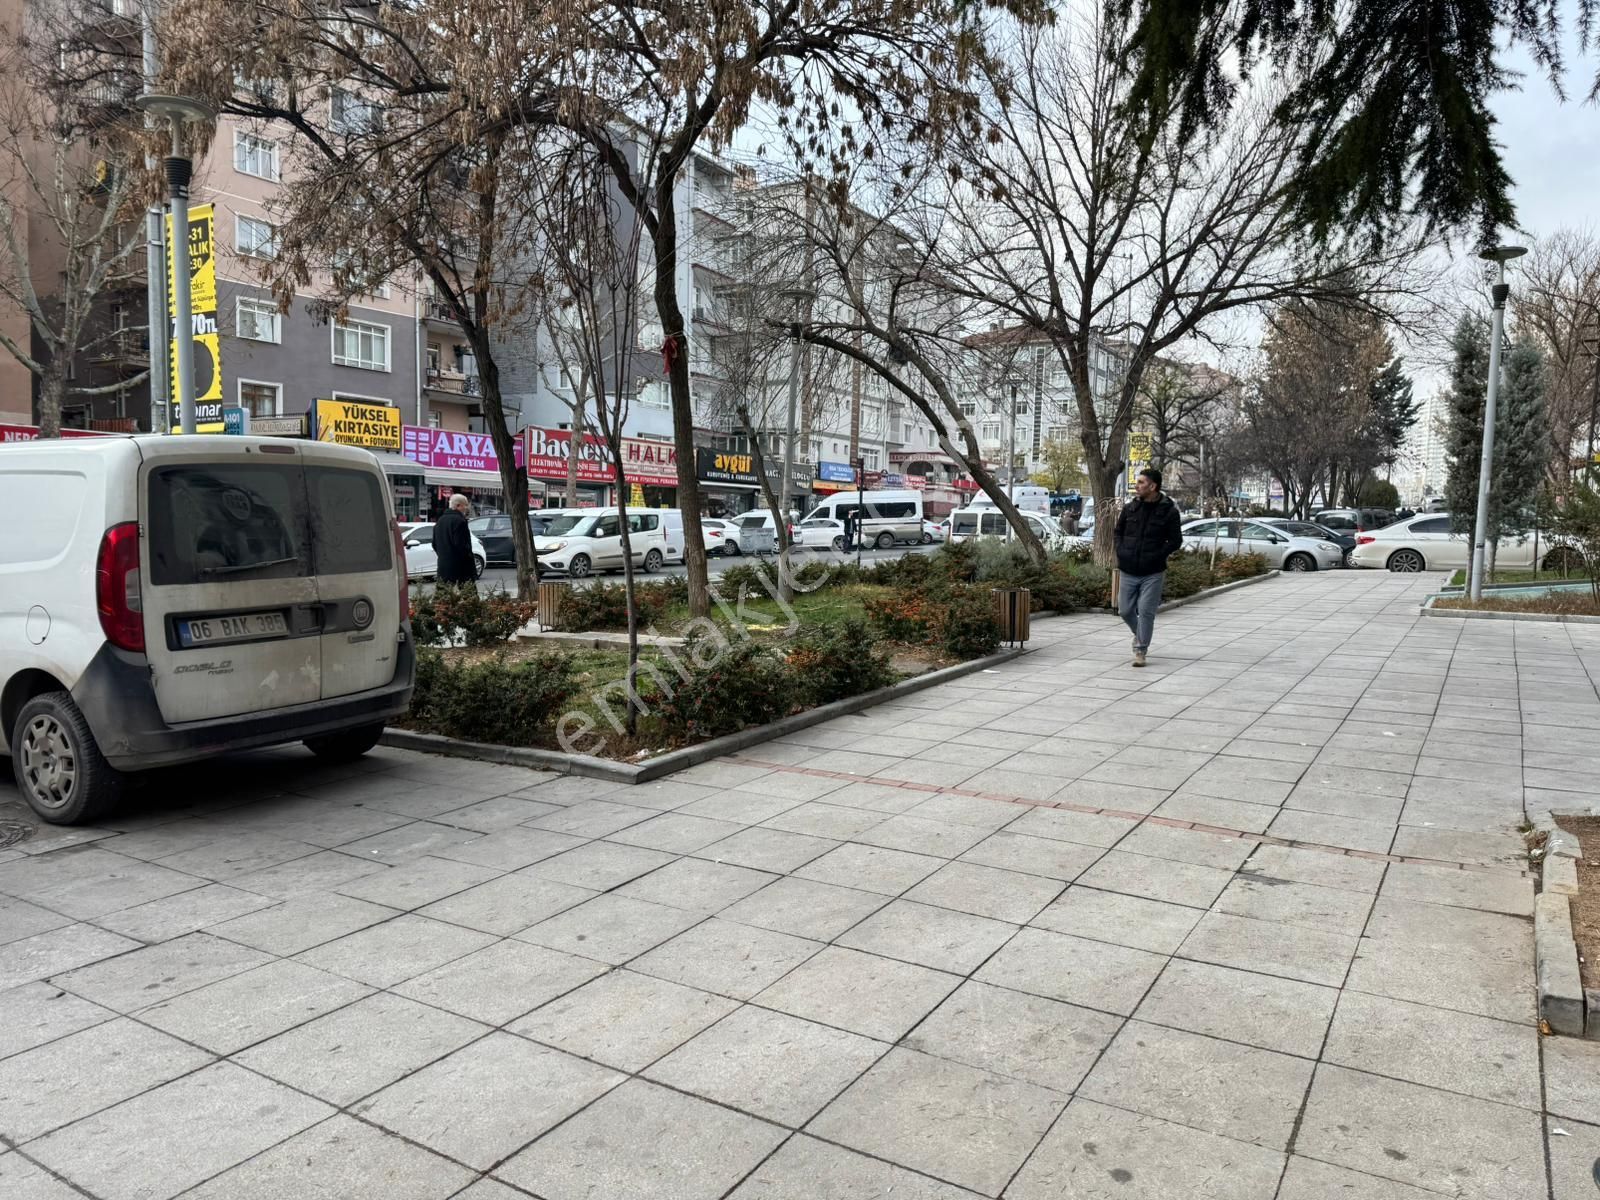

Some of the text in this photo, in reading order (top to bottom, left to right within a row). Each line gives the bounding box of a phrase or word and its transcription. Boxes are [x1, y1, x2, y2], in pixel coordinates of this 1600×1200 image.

[342, 404, 391, 423] YÜKSEL
[334, 420, 398, 438] KIRTASİYE
[335, 434, 364, 445] OYUNCAK
[433, 431, 498, 458] ARYA
[447, 455, 485, 468] İÇ GİYİM
[715, 453, 753, 474] aygül
[190, 614, 284, 640] 06 BAK 385
